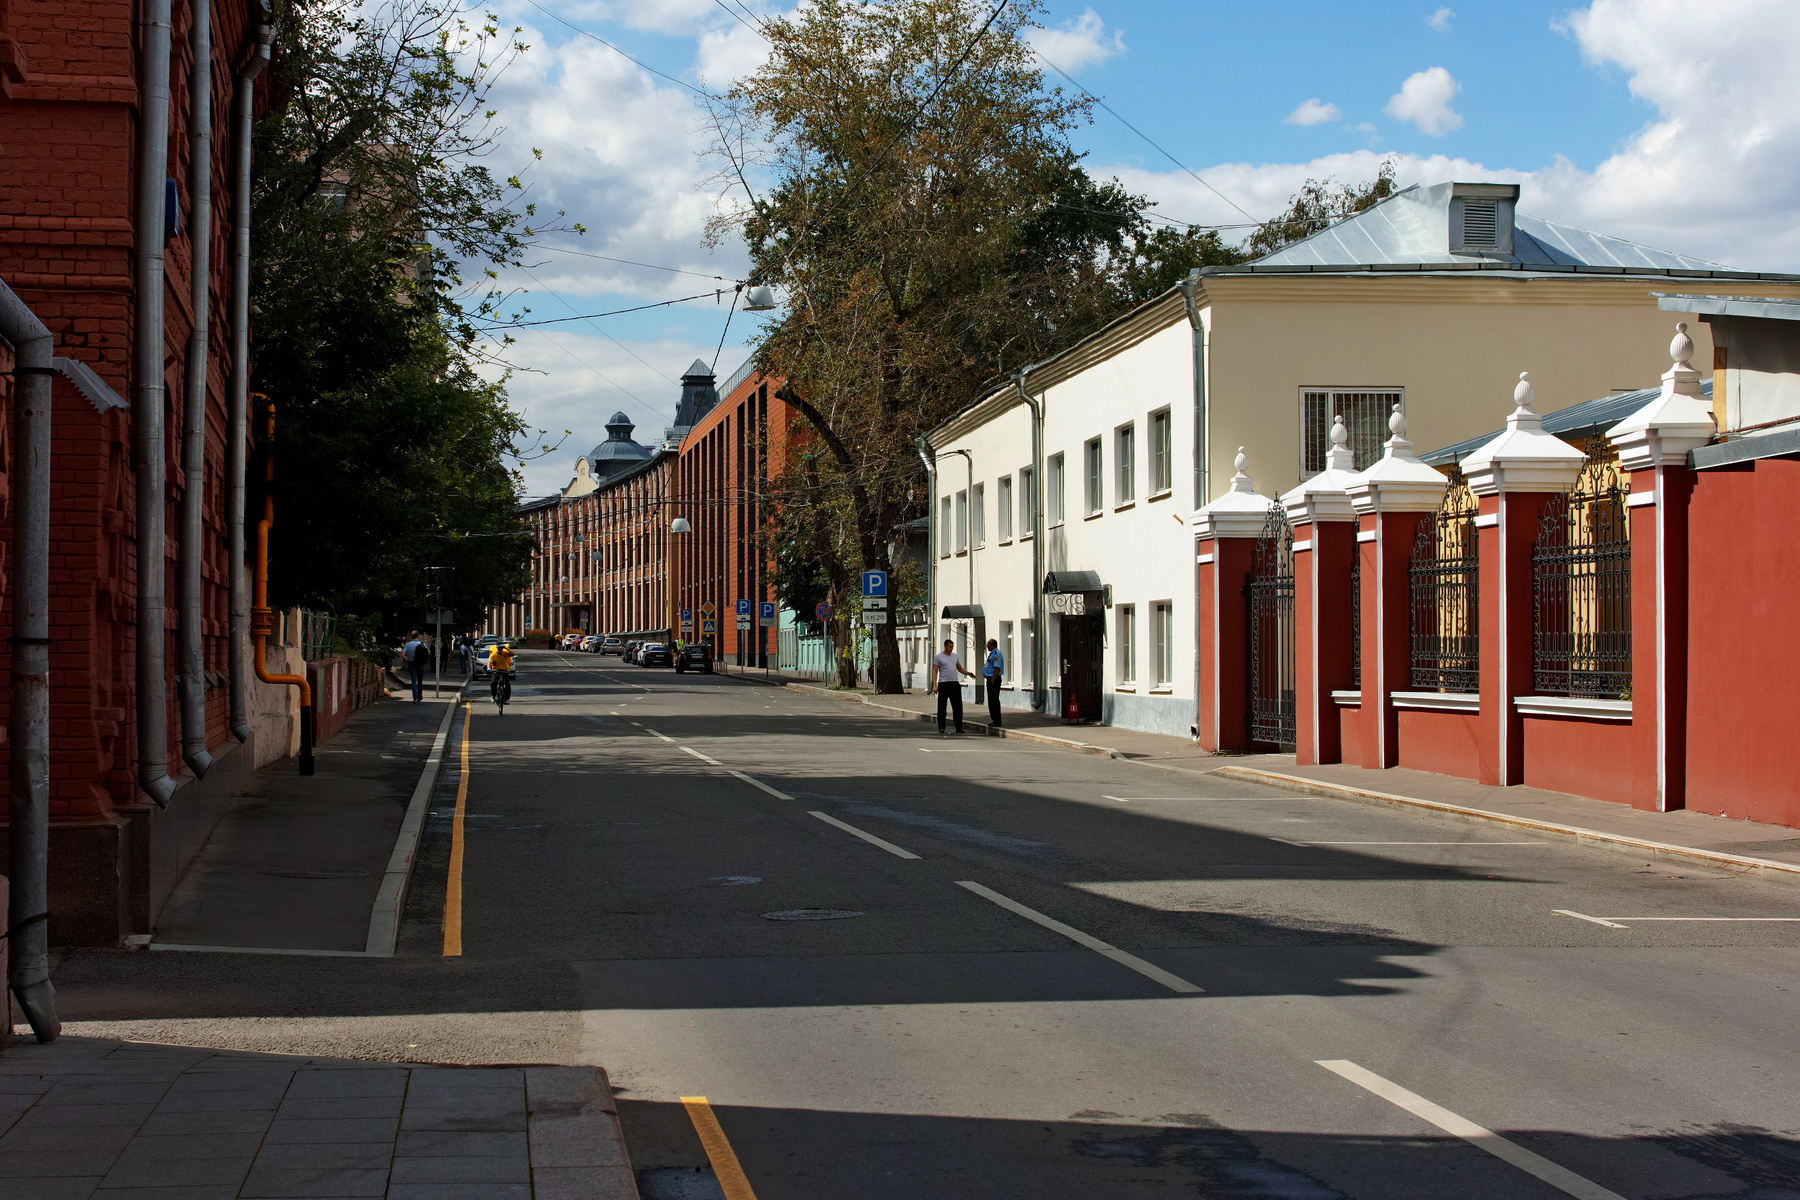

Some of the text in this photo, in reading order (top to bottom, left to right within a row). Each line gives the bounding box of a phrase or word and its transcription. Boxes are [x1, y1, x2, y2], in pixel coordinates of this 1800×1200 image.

[869, 574, 882, 594] P
[740, 600, 748, 612] P
[763, 604, 773, 617] P
[682, 610, 690, 619] P
